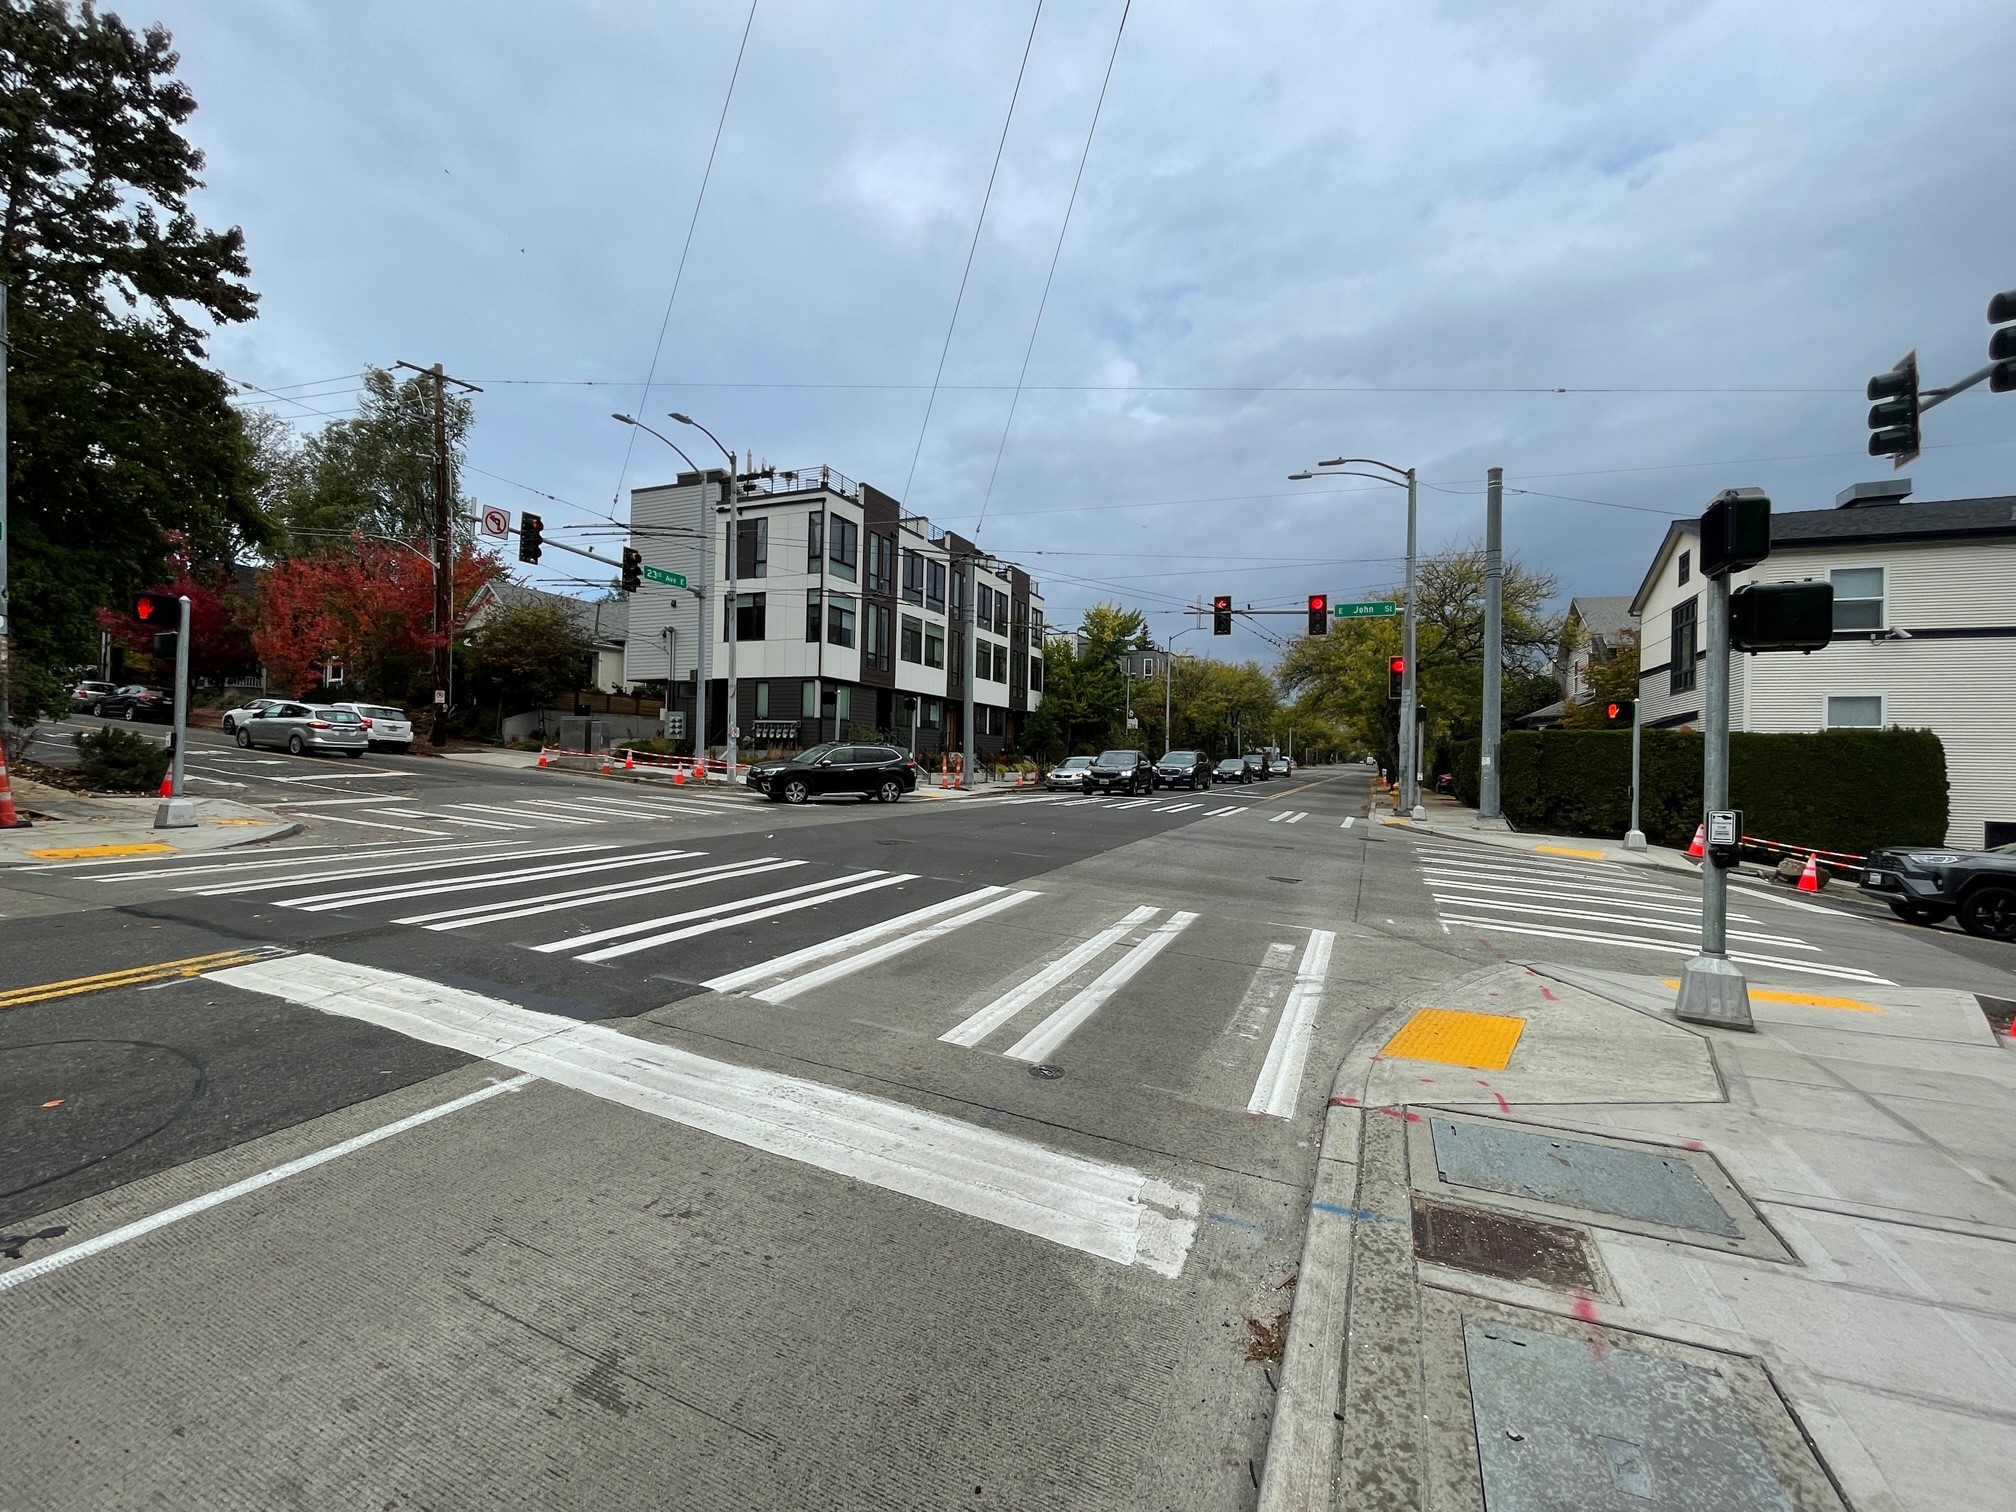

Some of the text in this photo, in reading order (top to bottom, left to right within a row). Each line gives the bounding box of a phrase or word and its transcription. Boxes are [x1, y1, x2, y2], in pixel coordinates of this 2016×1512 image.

[646, 569, 685, 586] 23rd Ave E
[1338, 605, 1393, 615] E John St
